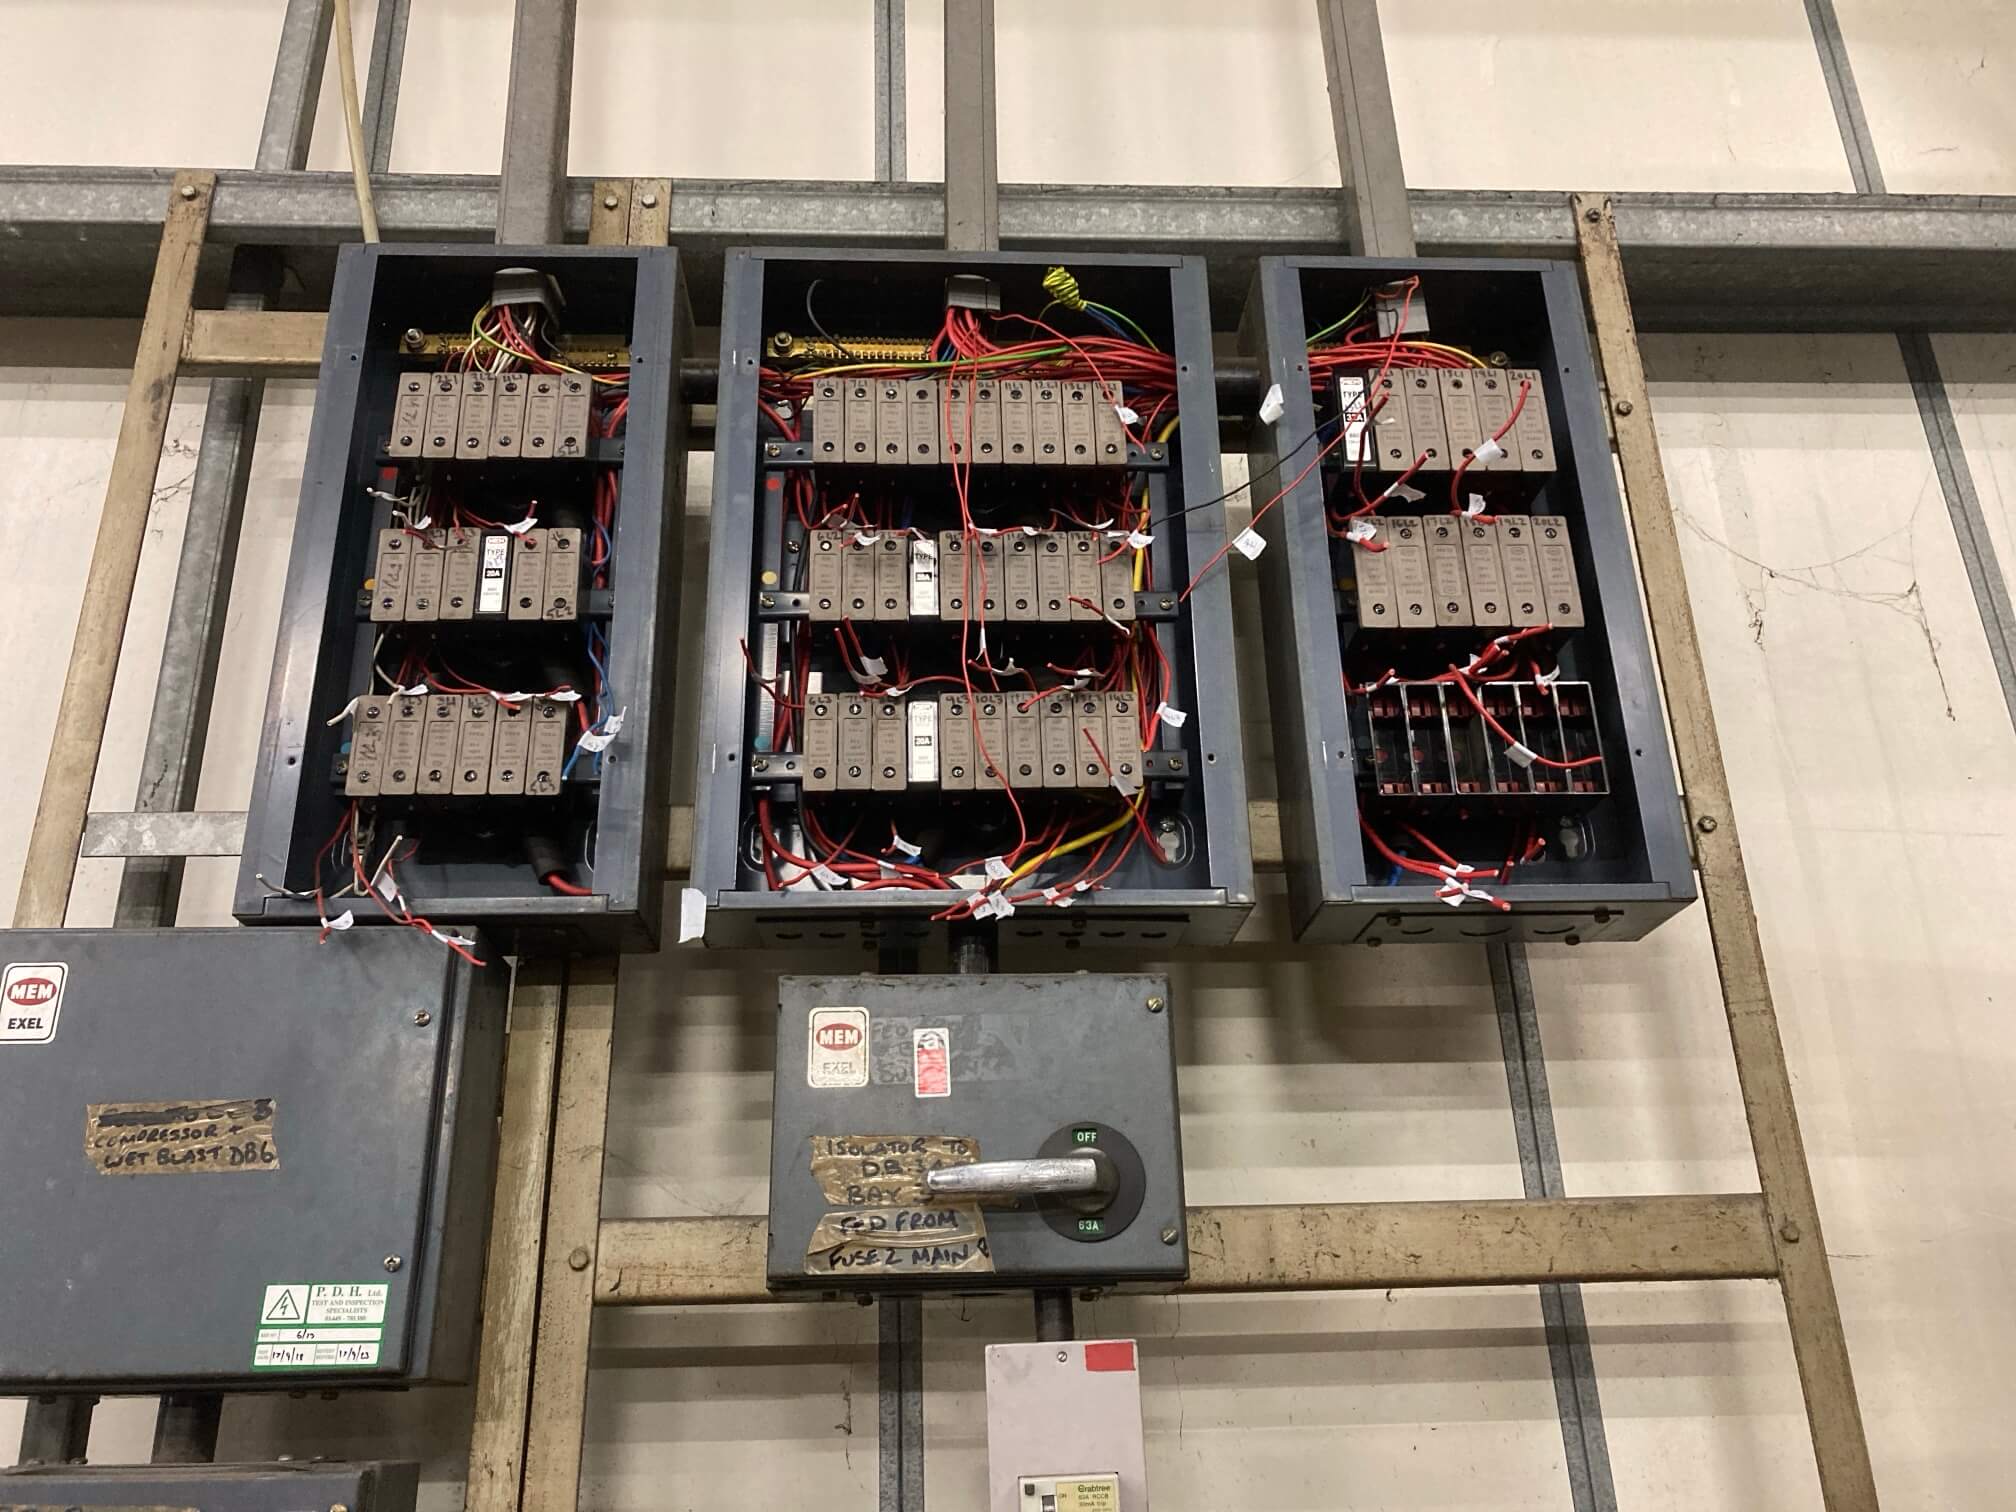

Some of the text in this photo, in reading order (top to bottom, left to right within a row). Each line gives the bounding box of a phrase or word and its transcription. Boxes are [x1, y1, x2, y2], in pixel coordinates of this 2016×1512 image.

[10, 983, 54, 1000] MEM
[8, 1018, 44, 1030] EXEL
[819, 1030, 859, 1045] MEM
[94, 1123, 218, 1149] COMPRESSOR
[1077, 1131, 1098, 1143] OFF
[103, 1140, 274, 1169] WET BLAST DB6
[827, 1137, 969, 1156] ISOLATOR TO
[847, 1184, 902, 1204] BAY
[895, 1209, 959, 1231] FROM
[1078, 1220, 1100, 1231] 63A
[828, 1245, 881, 1271] FUSE
[911, 1245, 969, 1266] MAIN
[316, 1286, 328, 1297] P.
[332, 1286, 345, 1297] D.
[349, 1286, 363, 1297] H.
[1078, 1484, 1112, 1493] Crabtree
